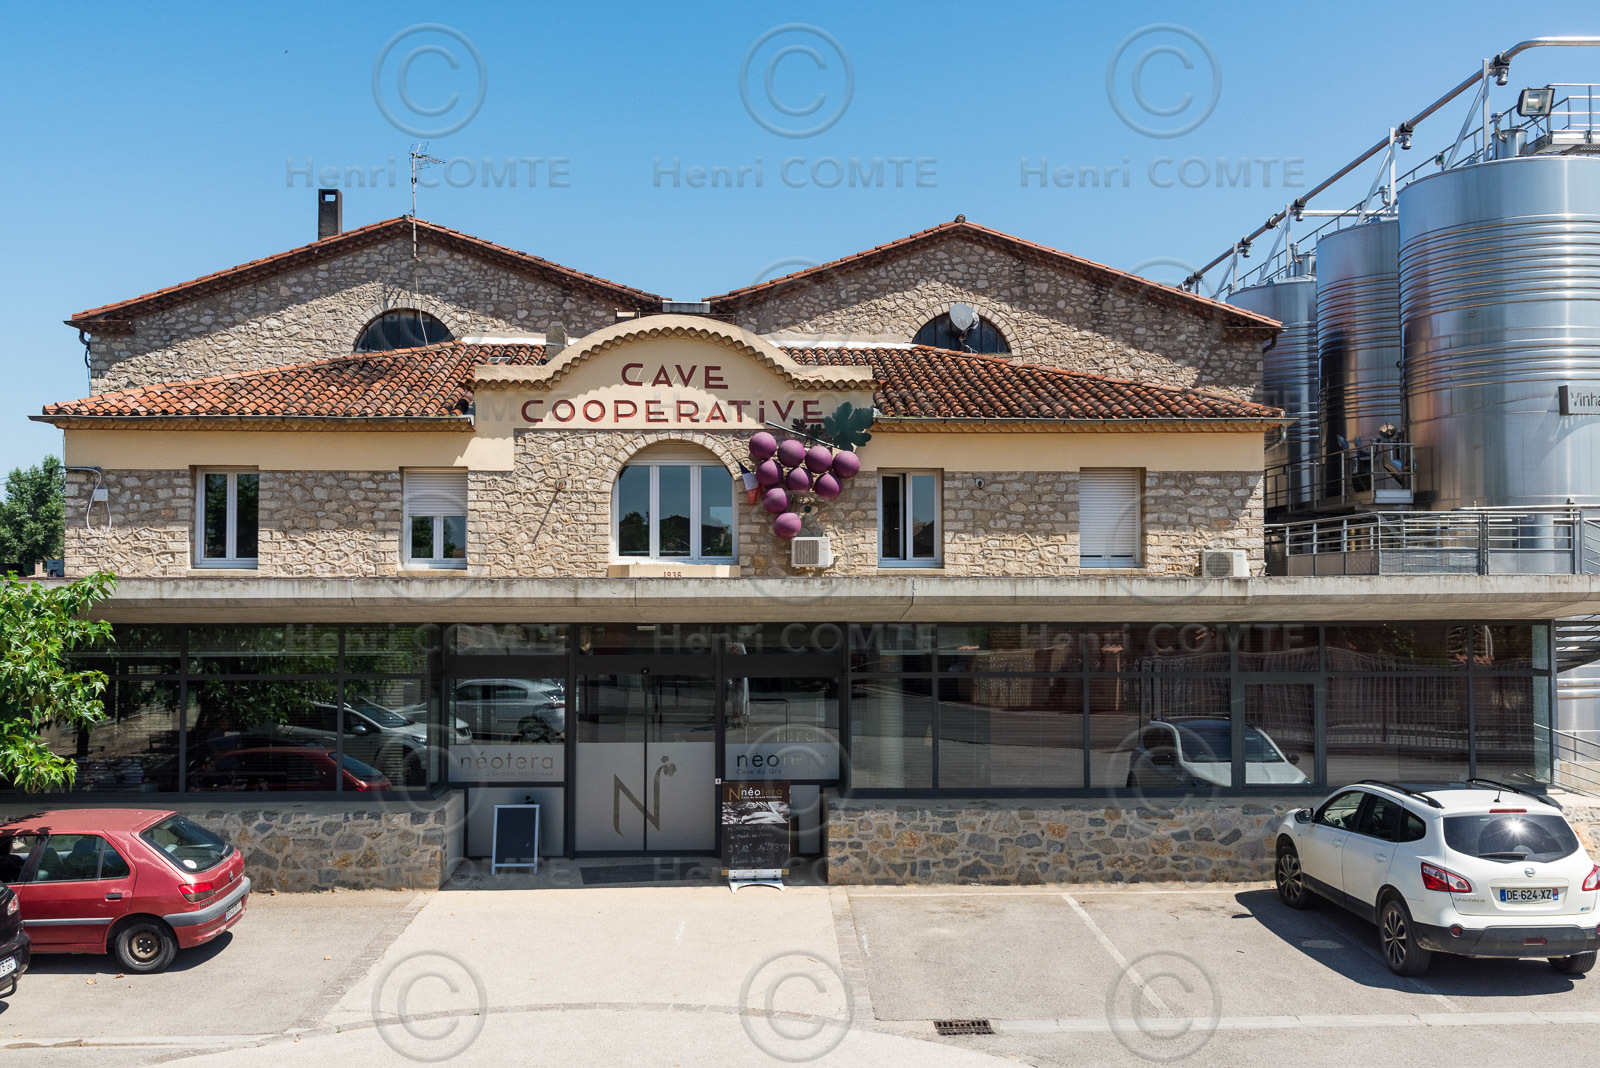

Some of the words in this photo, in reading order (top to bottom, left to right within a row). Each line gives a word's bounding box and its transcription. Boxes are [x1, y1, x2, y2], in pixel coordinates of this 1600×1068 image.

[621, 362, 728, 390] CAVE
[460, 751, 554, 769] néotera
[741, 787, 783, 796] néotera
[1506, 889, 1552, 900] DE-624-XZ
